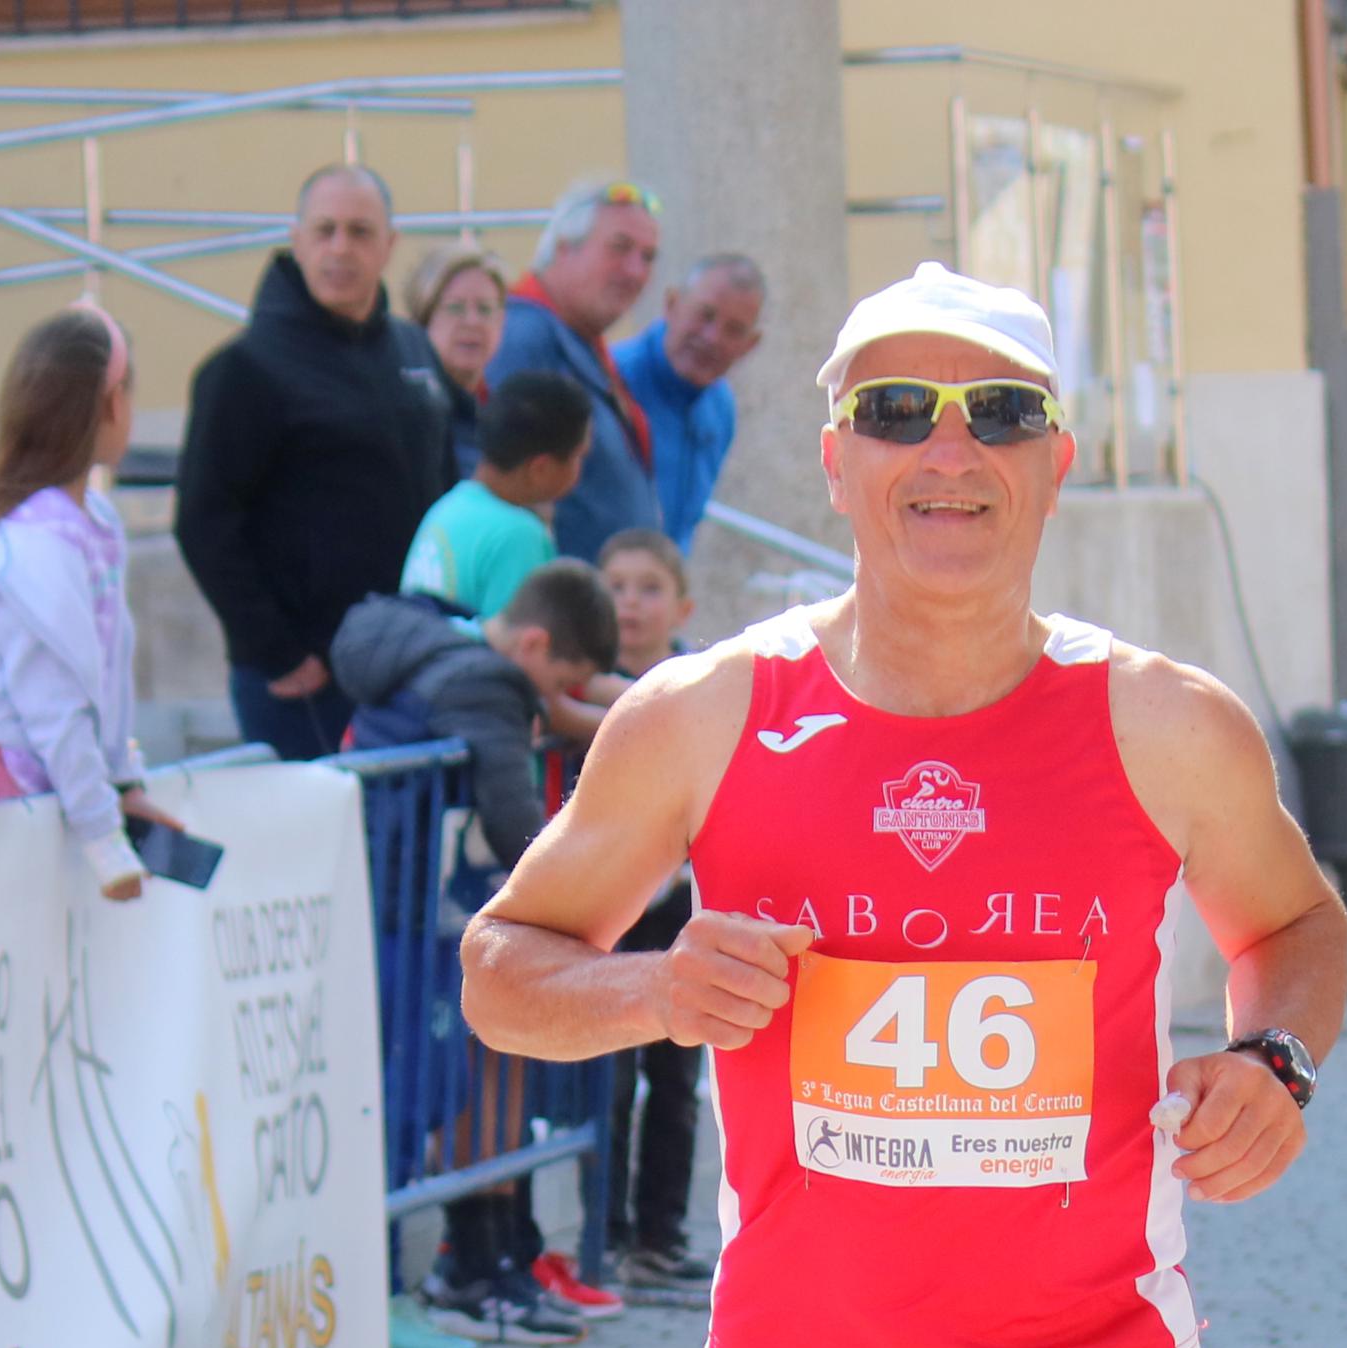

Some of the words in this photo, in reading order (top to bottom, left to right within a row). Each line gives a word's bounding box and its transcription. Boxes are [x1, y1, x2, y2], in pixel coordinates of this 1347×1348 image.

[900, 796, 965, 810] cuatro
[878, 810, 981, 829] CANTONES
[910, 831, 953, 841] ATLETISMO
[921, 841, 942, 849] CLUB
[844, 974, 1037, 1090] 46
[820, 1082, 873, 1111] Legua
[879, 1094, 983, 1113] Castellana
[989, 1094, 1018, 1112] del
[1023, 1092, 1083, 1112] Cerrato
[844, 1131, 934, 1169] INTEGRA
[951, 1134, 997, 1153] Eres
[1004, 1132, 1073, 1153] nuestra
